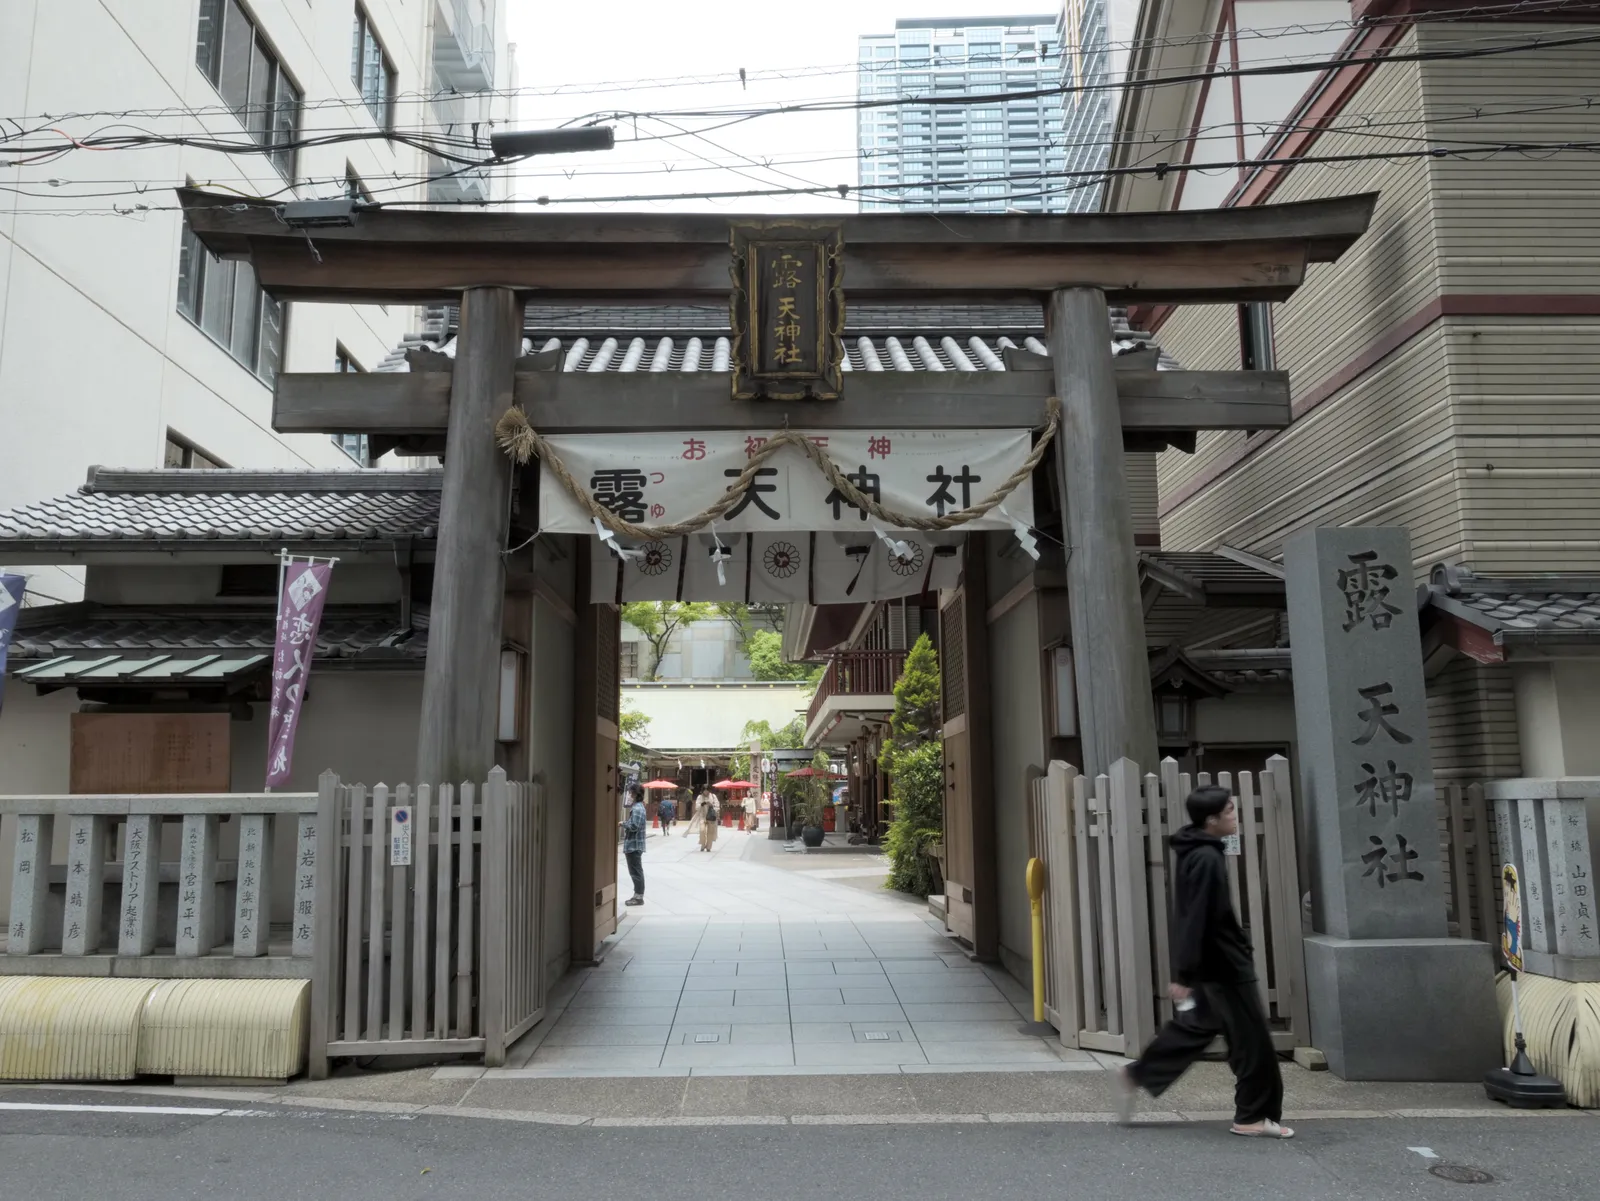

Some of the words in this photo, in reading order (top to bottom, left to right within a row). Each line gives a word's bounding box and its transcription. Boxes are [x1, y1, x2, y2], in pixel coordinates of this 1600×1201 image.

[771, 254, 803, 364] 露天神社
[590, 464, 982, 524] 露天神社
[650, 472, 666, 519] つゆ
[1337, 550, 1425, 889] 露天神社
[68, 829, 87, 939] 吉本晴彦
[296, 827, 316, 940] 平岩洋服店
